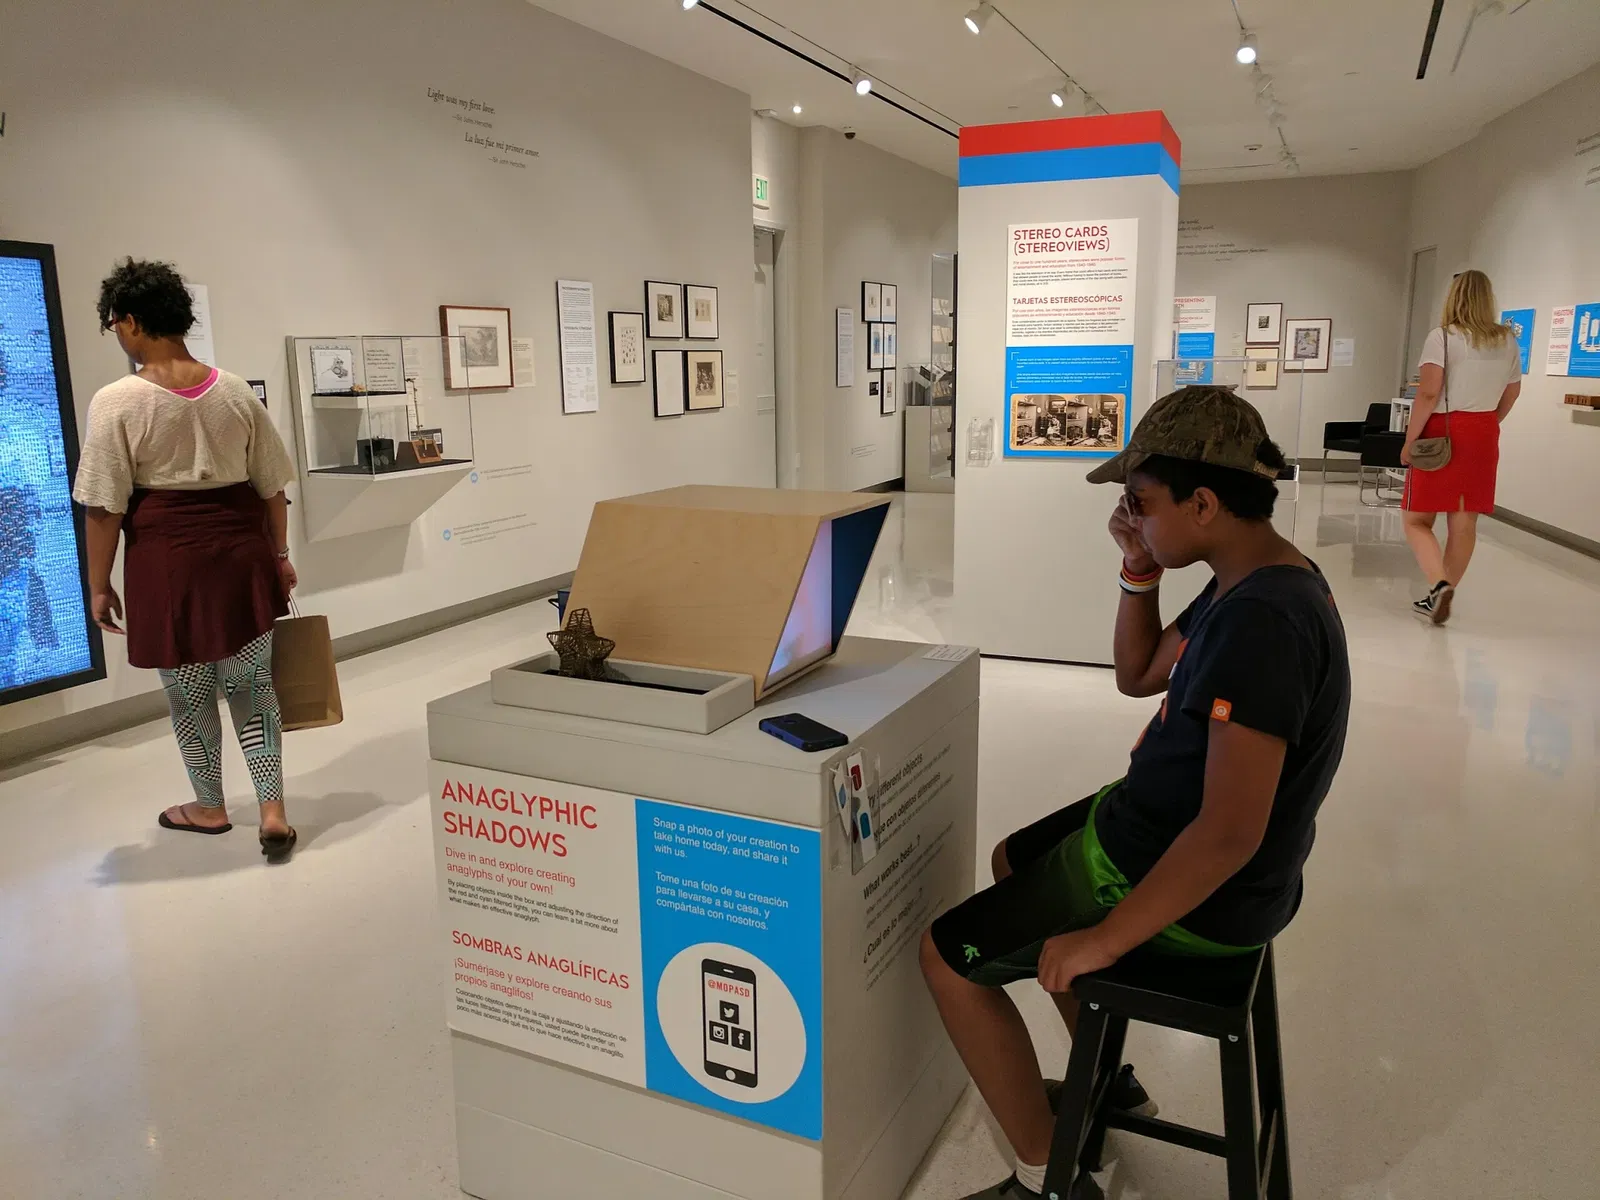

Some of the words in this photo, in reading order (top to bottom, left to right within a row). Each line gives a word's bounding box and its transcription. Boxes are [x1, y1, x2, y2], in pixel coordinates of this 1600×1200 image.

[428, 87, 444, 102] Light
[446, 96, 457, 104] was
[469, 98, 481, 111] first
[465, 132, 473, 142] La
[1014, 228, 1061, 240] STEREO
[1065, 225, 1108, 238] CARDS
[1014, 237, 1110, 256] (STEREOVIEWS)
[1013, 297, 1048, 305] TARJETAS
[1050, 294, 1123, 304] ESTEREOSCÓPICAS
[441, 779, 598, 829] ANAGLYPHIC
[443, 811, 568, 857] SHADOWS
[654, 817, 676, 830] Snap
[688, 825, 712, 836] photo
[715, 830, 724, 838] of
[727, 833, 747, 843] your
[750, 838, 787, 851] creation
[790, 844, 799, 853] to
[654, 831, 672, 844] take
[675, 835, 700, 847] home
[733, 848, 750, 857] and
[753, 850, 779, 863] share
[782, 855, 787, 865] it
[654, 845, 672, 854] with
[675, 849, 687, 857] us.
[446, 847, 465, 859] Dive
[469, 852, 476, 862] in
[480, 857, 496, 866] and
[499, 861, 533, 875] explore
[536, 870, 575, 887] creating
[447, 863, 492, 880] anaglyphs
[496, 874, 504, 882] of
[507, 877, 527, 888] your
[530, 883, 553, 894] own!
[863, 876, 880, 900] What
[881, 858, 900, 882] works
[656, 871, 679, 884] Tome
[682, 879, 700, 888] una
[701, 881, 718, 892] foto
[721, 886, 732, 896] de
[735, 890, 746, 898] su
[748, 893, 788, 908] creación
[656, 886, 675, 896] para
[677, 889, 712, 904] llevarse
[724, 900, 734, 909] su
[764, 910, 770, 918] y
[656, 899, 705, 915] compártala
[707, 910, 724, 919] con
[726, 914, 768, 930] nosotros.
[453, 931, 522, 960] SOMBRAS
[527, 951, 629, 988] ANAGLÍFICAS
[455, 958, 504, 978] ¡Sumérjase
[508, 974, 512, 982] y
[516, 976, 549, 991] explore
[552, 986, 591, 1002] creando
[595, 998, 612, 1008] sus
[455, 973, 488, 988] propios
[490, 982, 533, 1000] anaglifos!
[708, 979, 750, 998] @MOPASD
